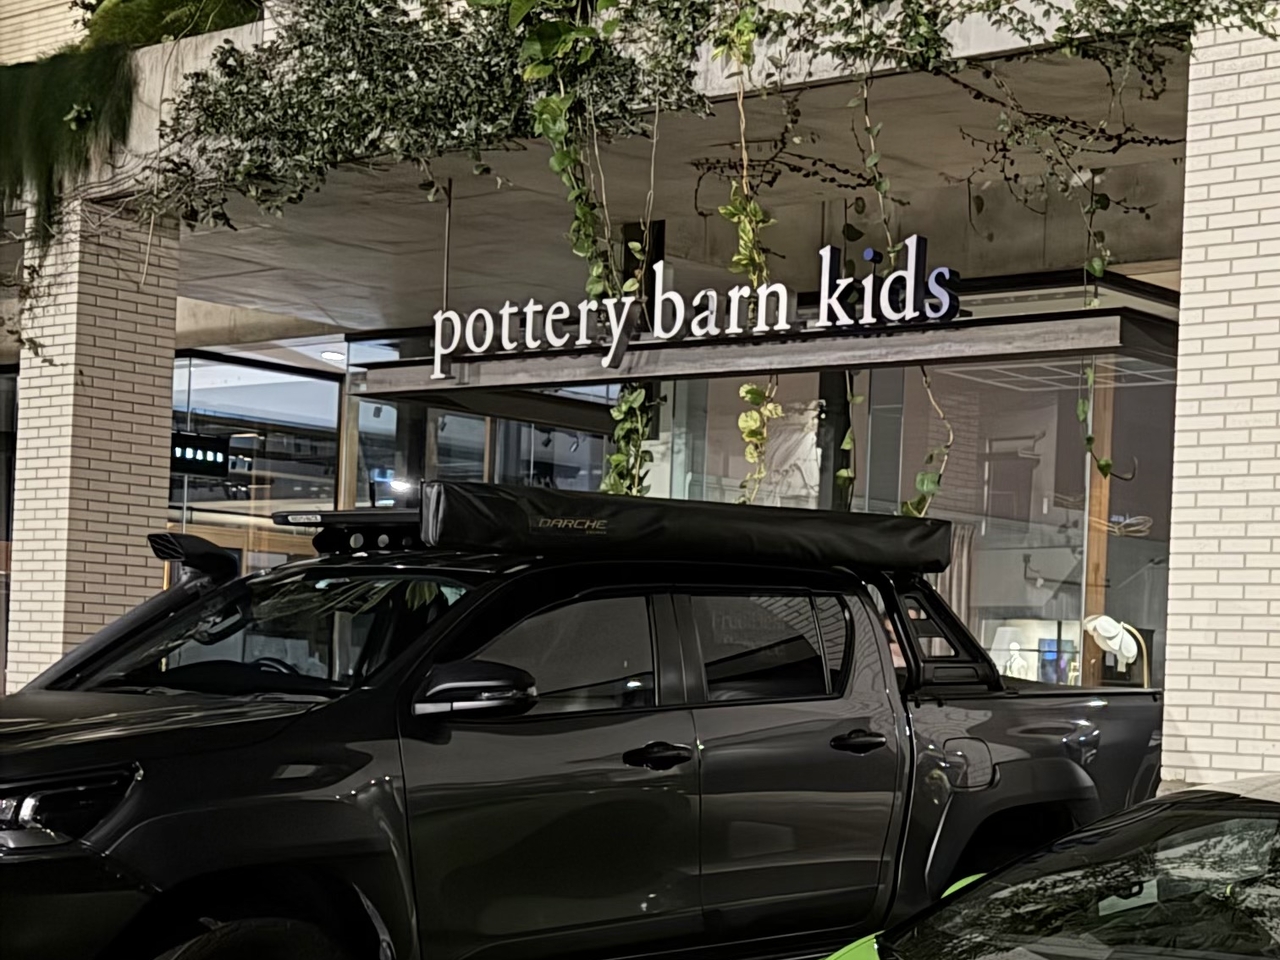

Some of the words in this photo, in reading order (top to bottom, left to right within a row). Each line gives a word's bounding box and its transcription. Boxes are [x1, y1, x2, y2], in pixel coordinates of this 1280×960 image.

[430, 295, 636, 380] pottery
[652, 260, 792, 340] barn
[815, 234, 954, 328] kids
[538, 518, 608, 530] DARCHE
